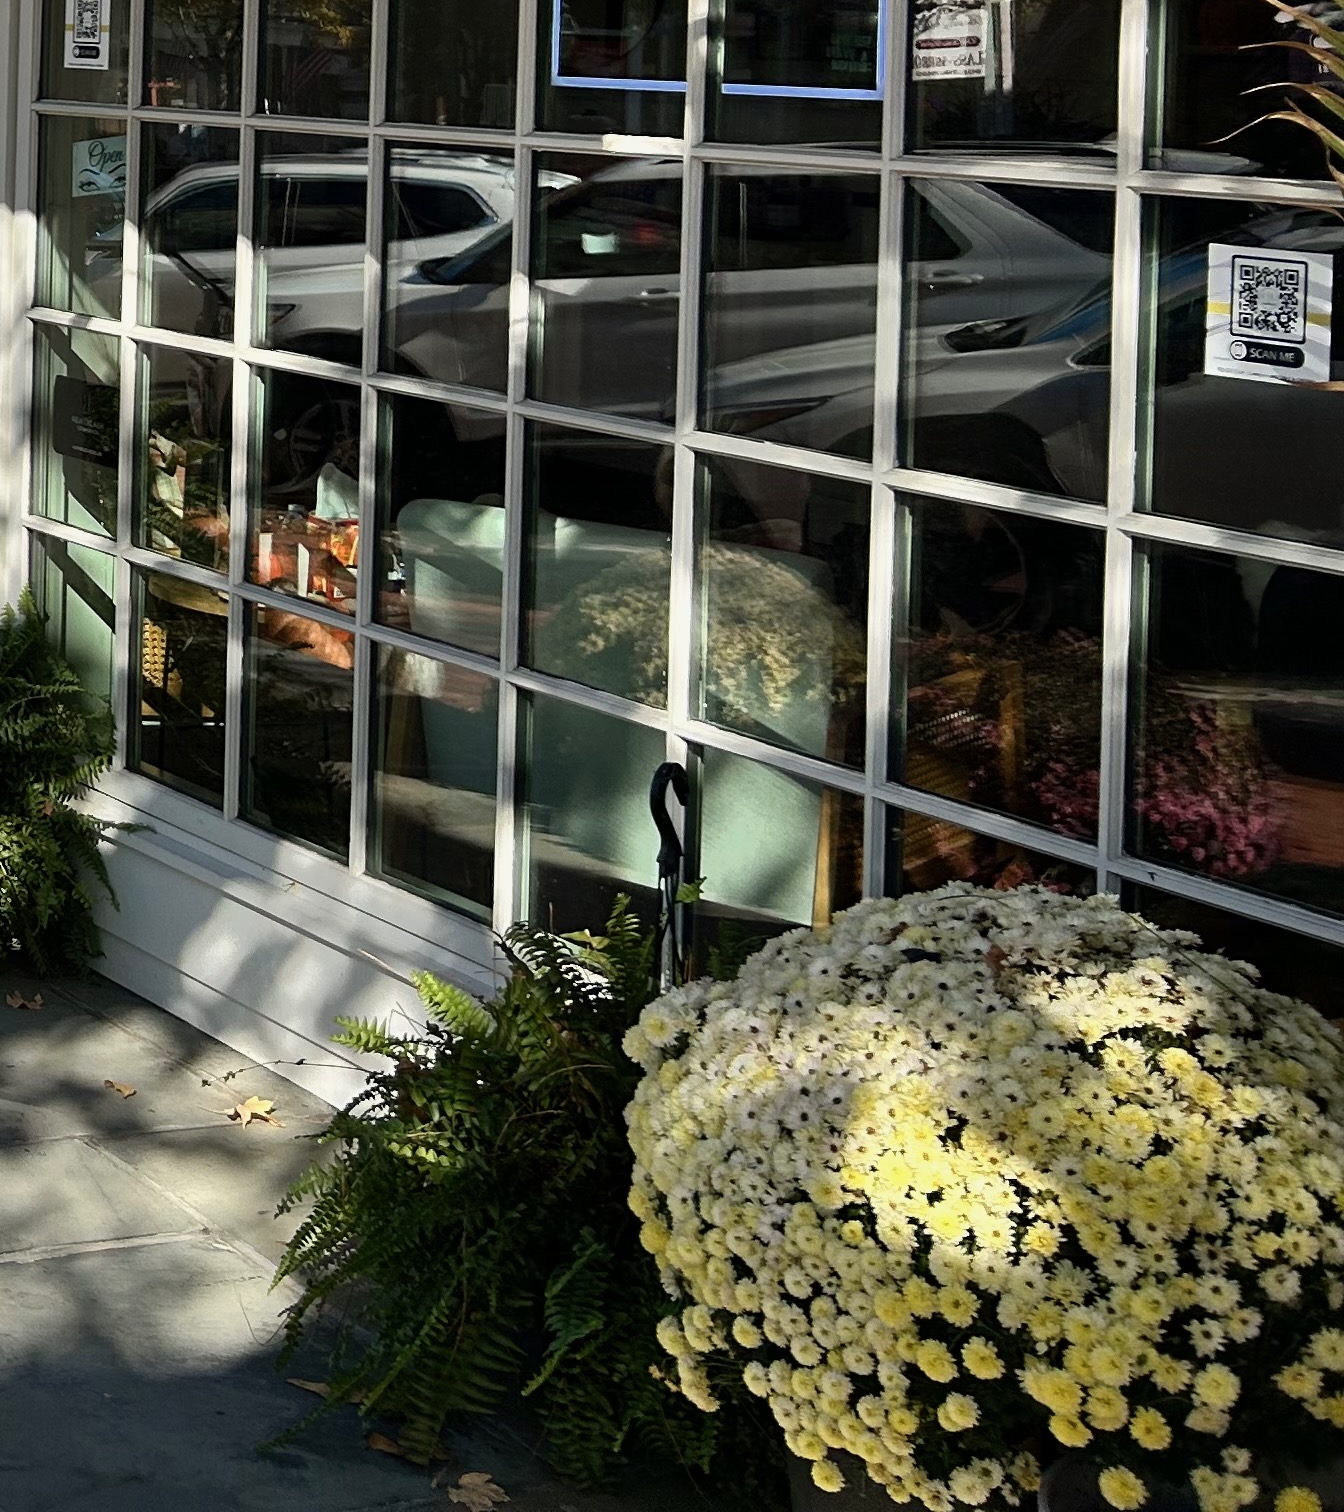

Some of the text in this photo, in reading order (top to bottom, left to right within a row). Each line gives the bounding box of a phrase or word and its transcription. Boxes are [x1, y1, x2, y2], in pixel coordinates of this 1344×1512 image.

[87, 140, 124, 173] Open
[1249, 348, 1295, 363] SCAN ME
